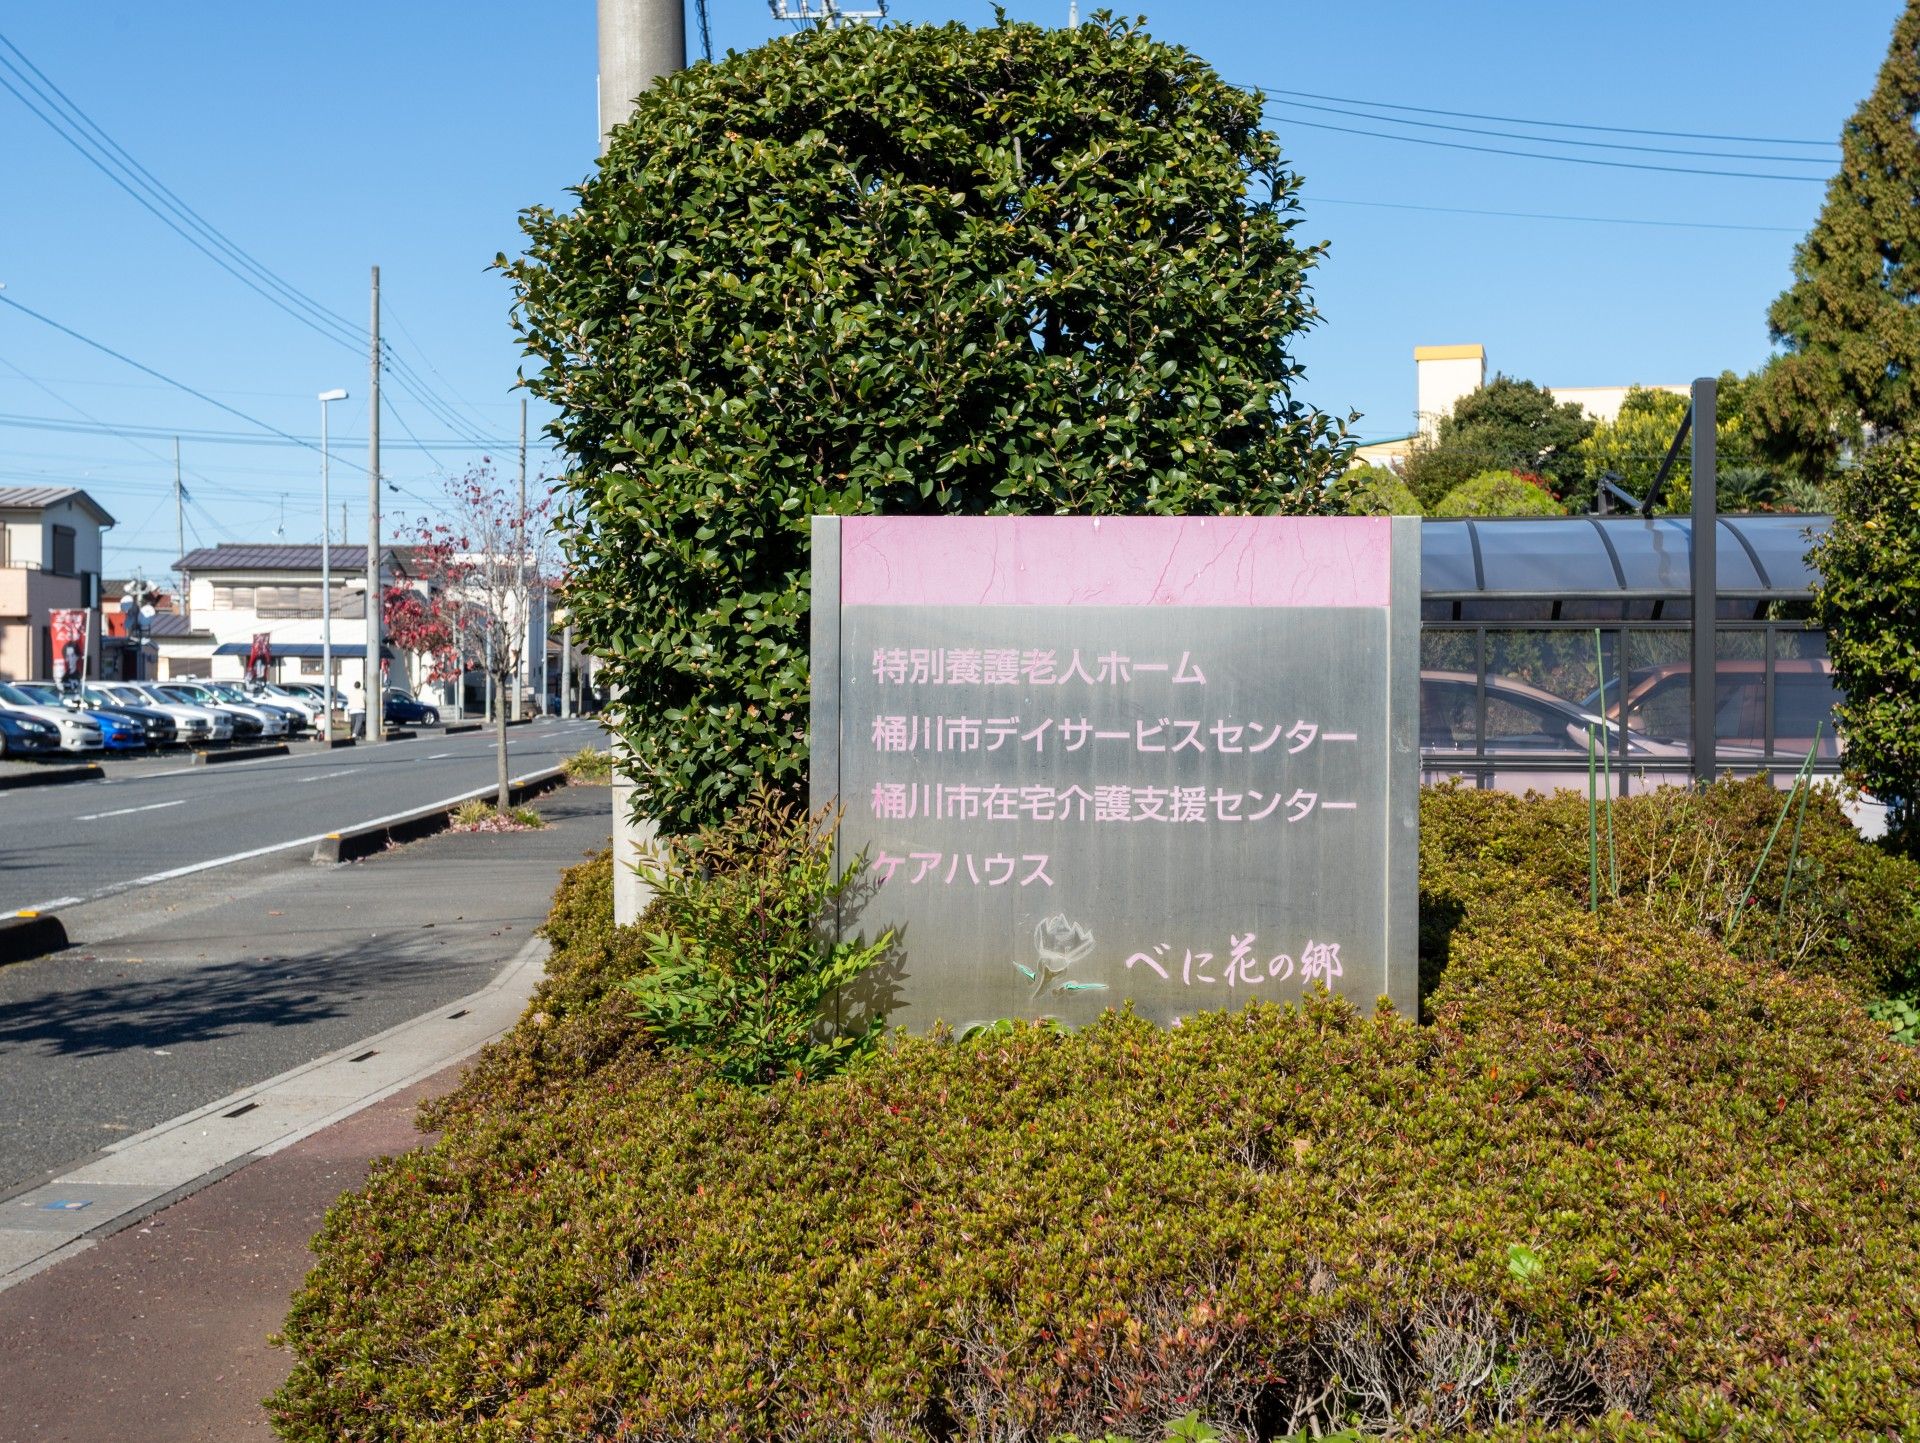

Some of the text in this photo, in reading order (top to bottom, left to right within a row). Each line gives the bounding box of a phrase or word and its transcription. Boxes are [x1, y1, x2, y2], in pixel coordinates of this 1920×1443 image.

[872, 649, 1207, 684] 特別養護老人ホーム
[872, 715, 1358, 753] 桶川市デイサービスセンター
[872, 783, 1358, 822] 桶川市在宅介護支援センター
[872, 851, 1054, 886] ケアハウス
[1125, 932, 1344, 991] べに花の郷
